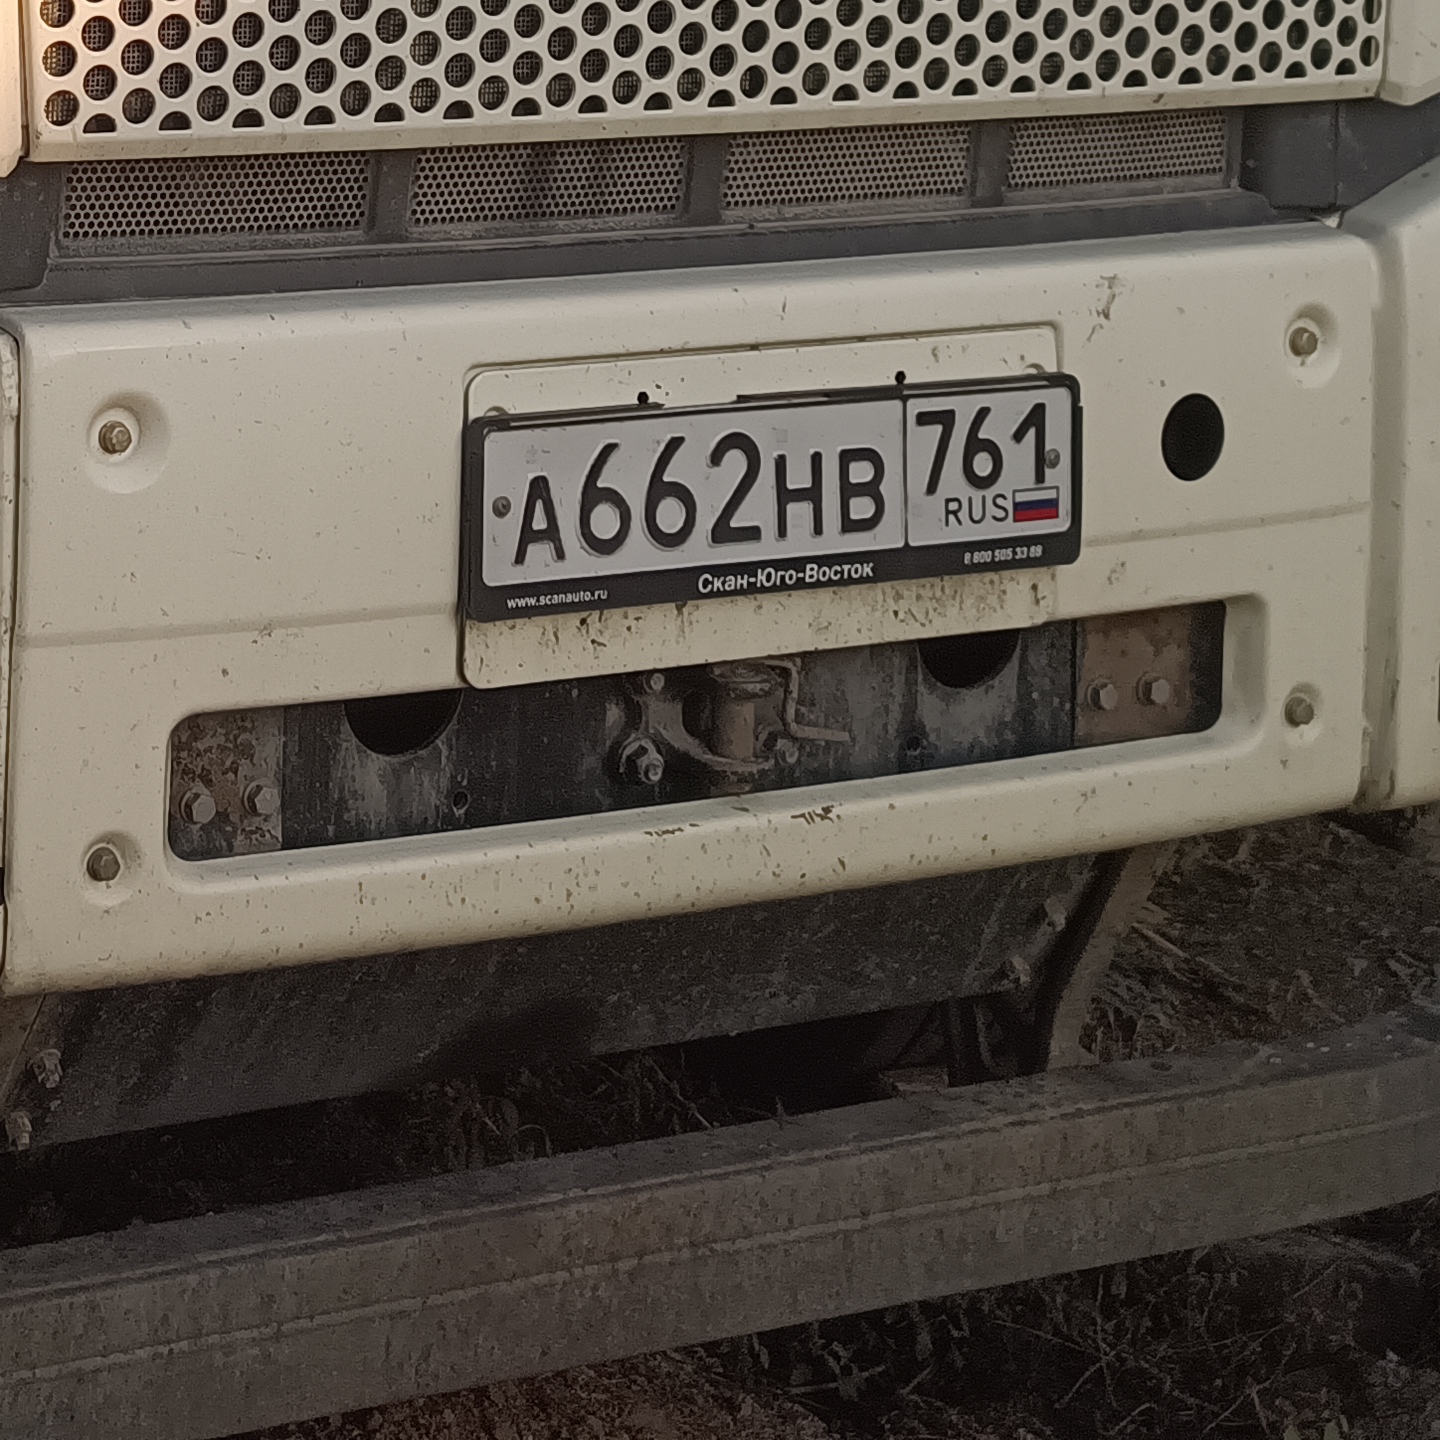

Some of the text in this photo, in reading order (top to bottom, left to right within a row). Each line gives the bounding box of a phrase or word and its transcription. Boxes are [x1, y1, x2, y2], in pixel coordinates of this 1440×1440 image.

[915, 402, 1046, 496] 761
[943, 493, 1009, 527] RUS
[697, 562, 874, 594] Скан-Юго-Восток
[507, 588, 609, 609] www.scanauto.ru
